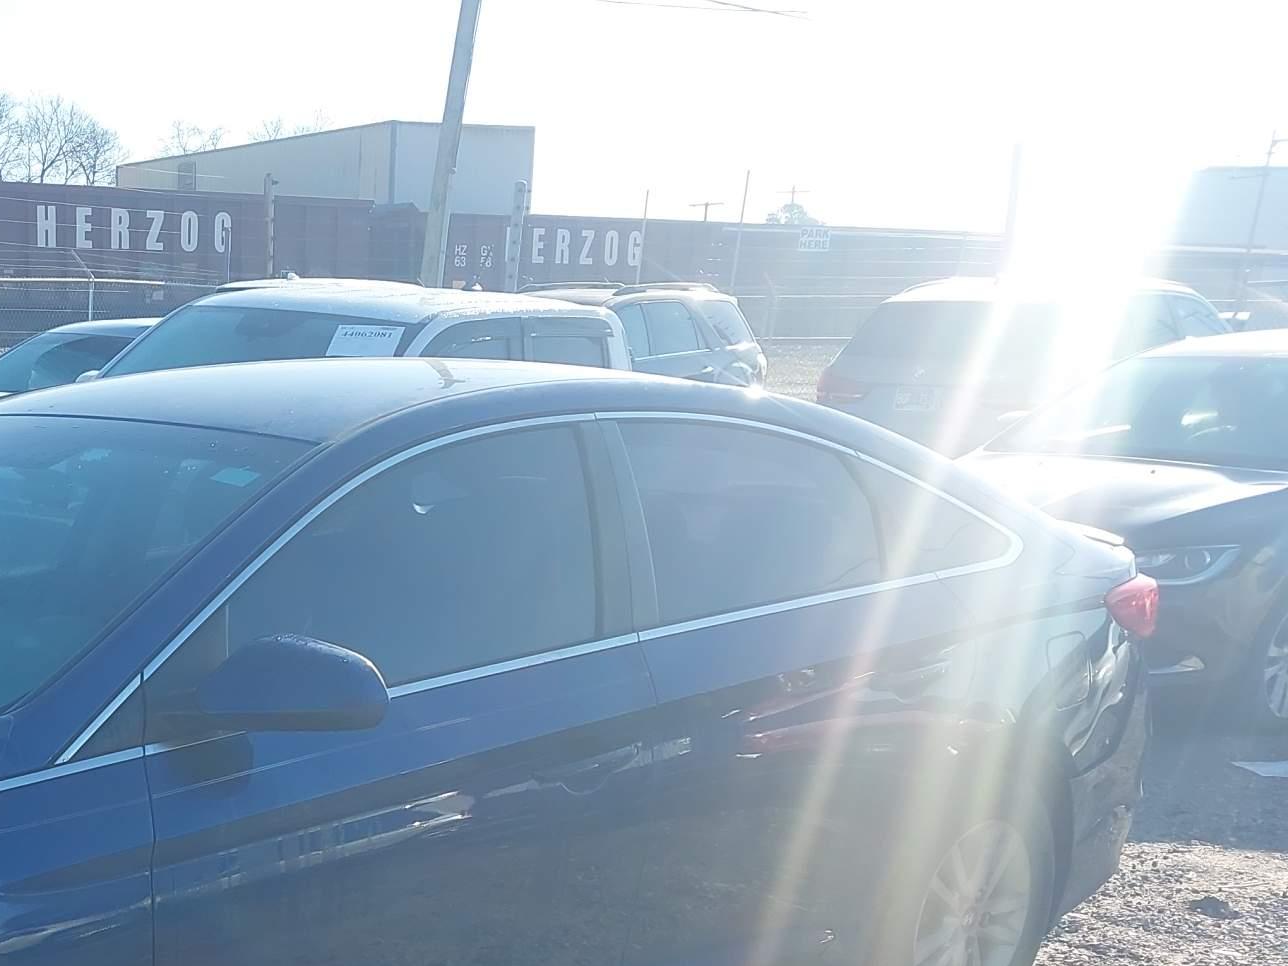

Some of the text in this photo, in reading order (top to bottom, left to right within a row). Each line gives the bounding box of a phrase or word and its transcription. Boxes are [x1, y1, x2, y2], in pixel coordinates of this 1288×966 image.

[36, 205, 232, 253] HERZOG
[800, 228, 830, 239] PARK
[454, 244, 467, 256] HZ
[505, 226, 643, 267] ERZOG
[799, 239, 830, 250] HERE
